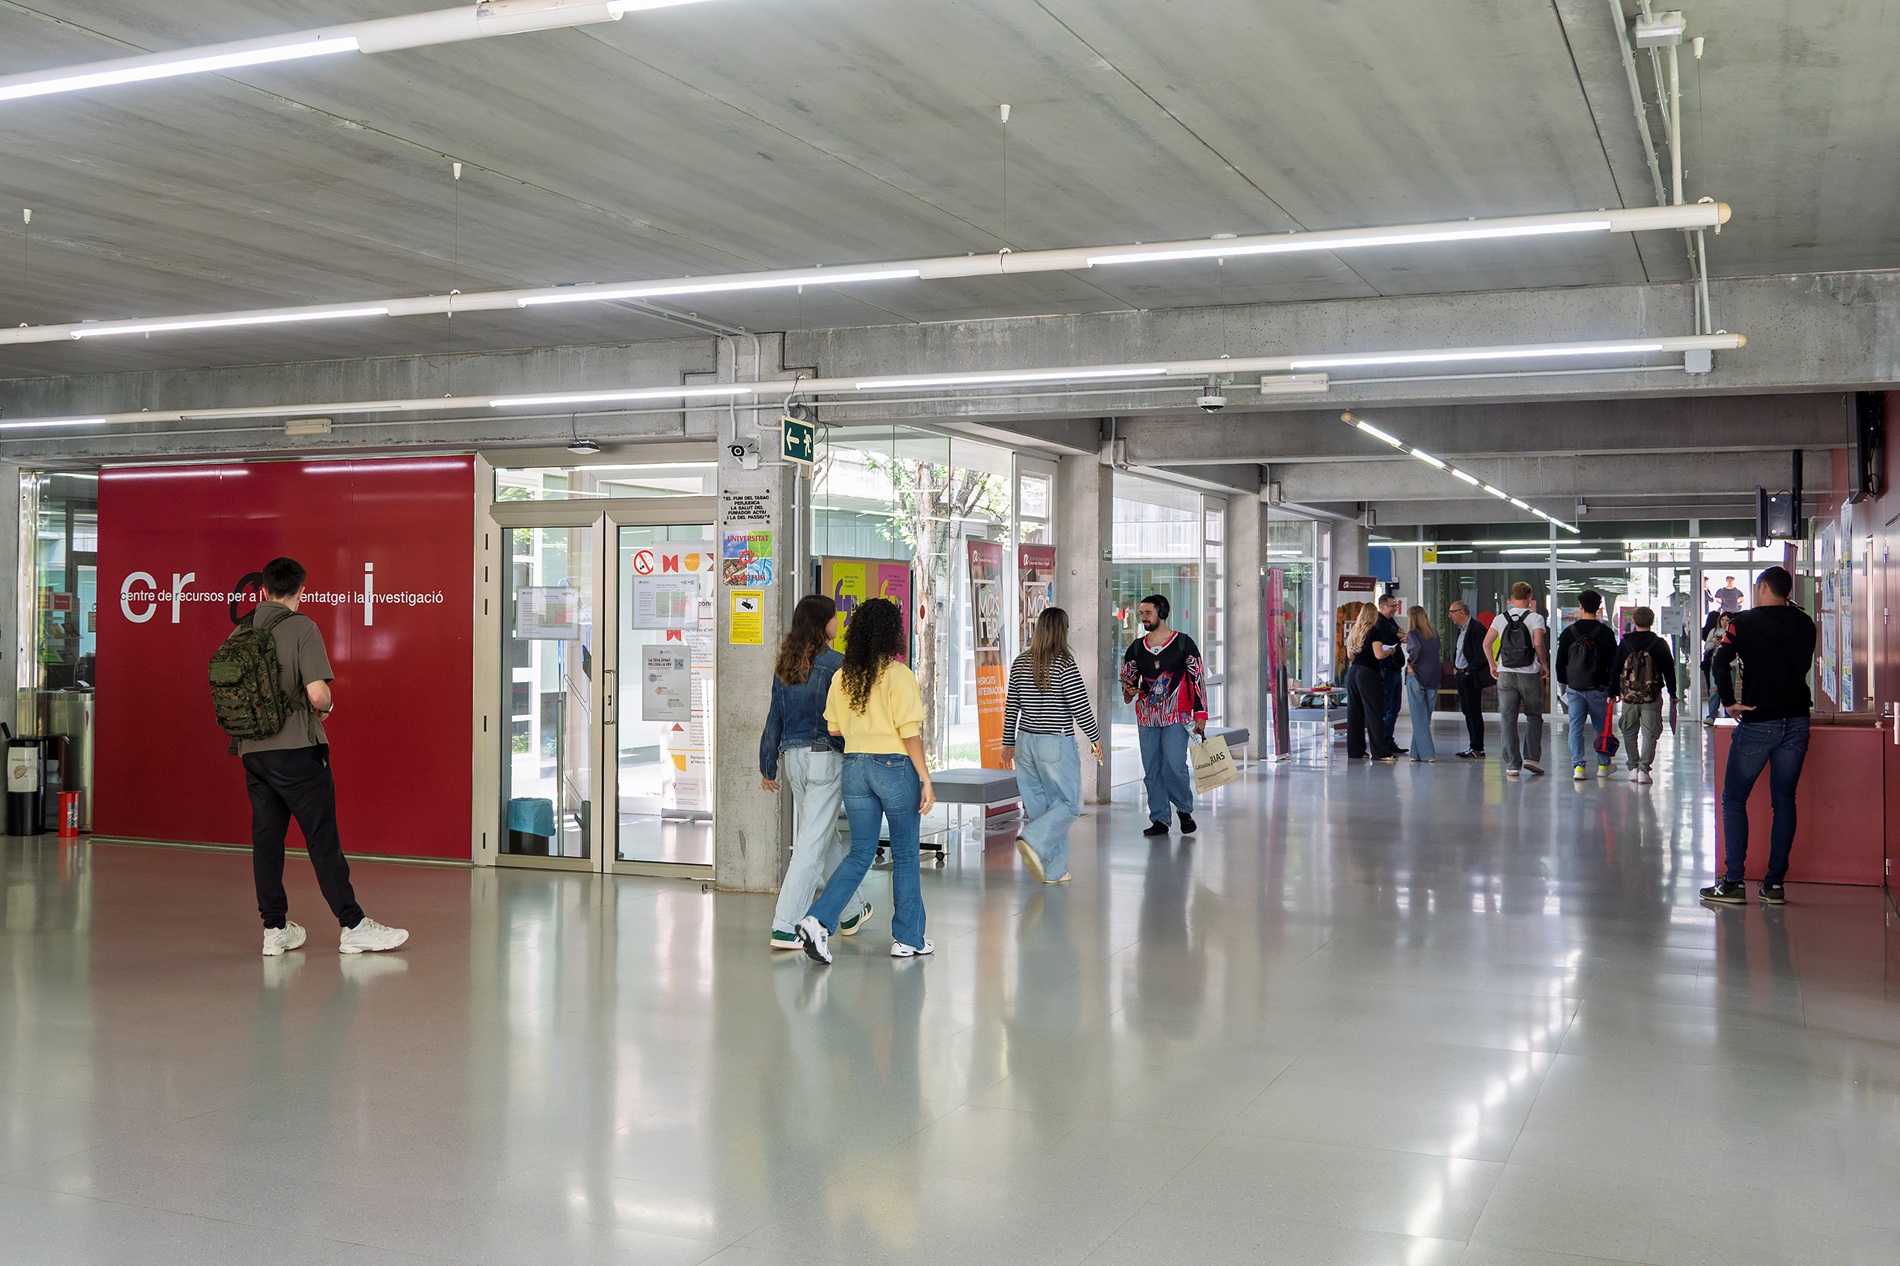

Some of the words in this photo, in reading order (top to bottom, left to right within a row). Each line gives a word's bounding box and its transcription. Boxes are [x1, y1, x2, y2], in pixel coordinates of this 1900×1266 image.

[120, 590, 154, 602] centre
[158, 590, 172, 602] de
[175, 592, 224, 602] recursos
[227, 592, 246, 604] per
[250, 593, 256, 602] a
[354, 592, 364, 603] la
[368, 591, 444, 606] investigació
